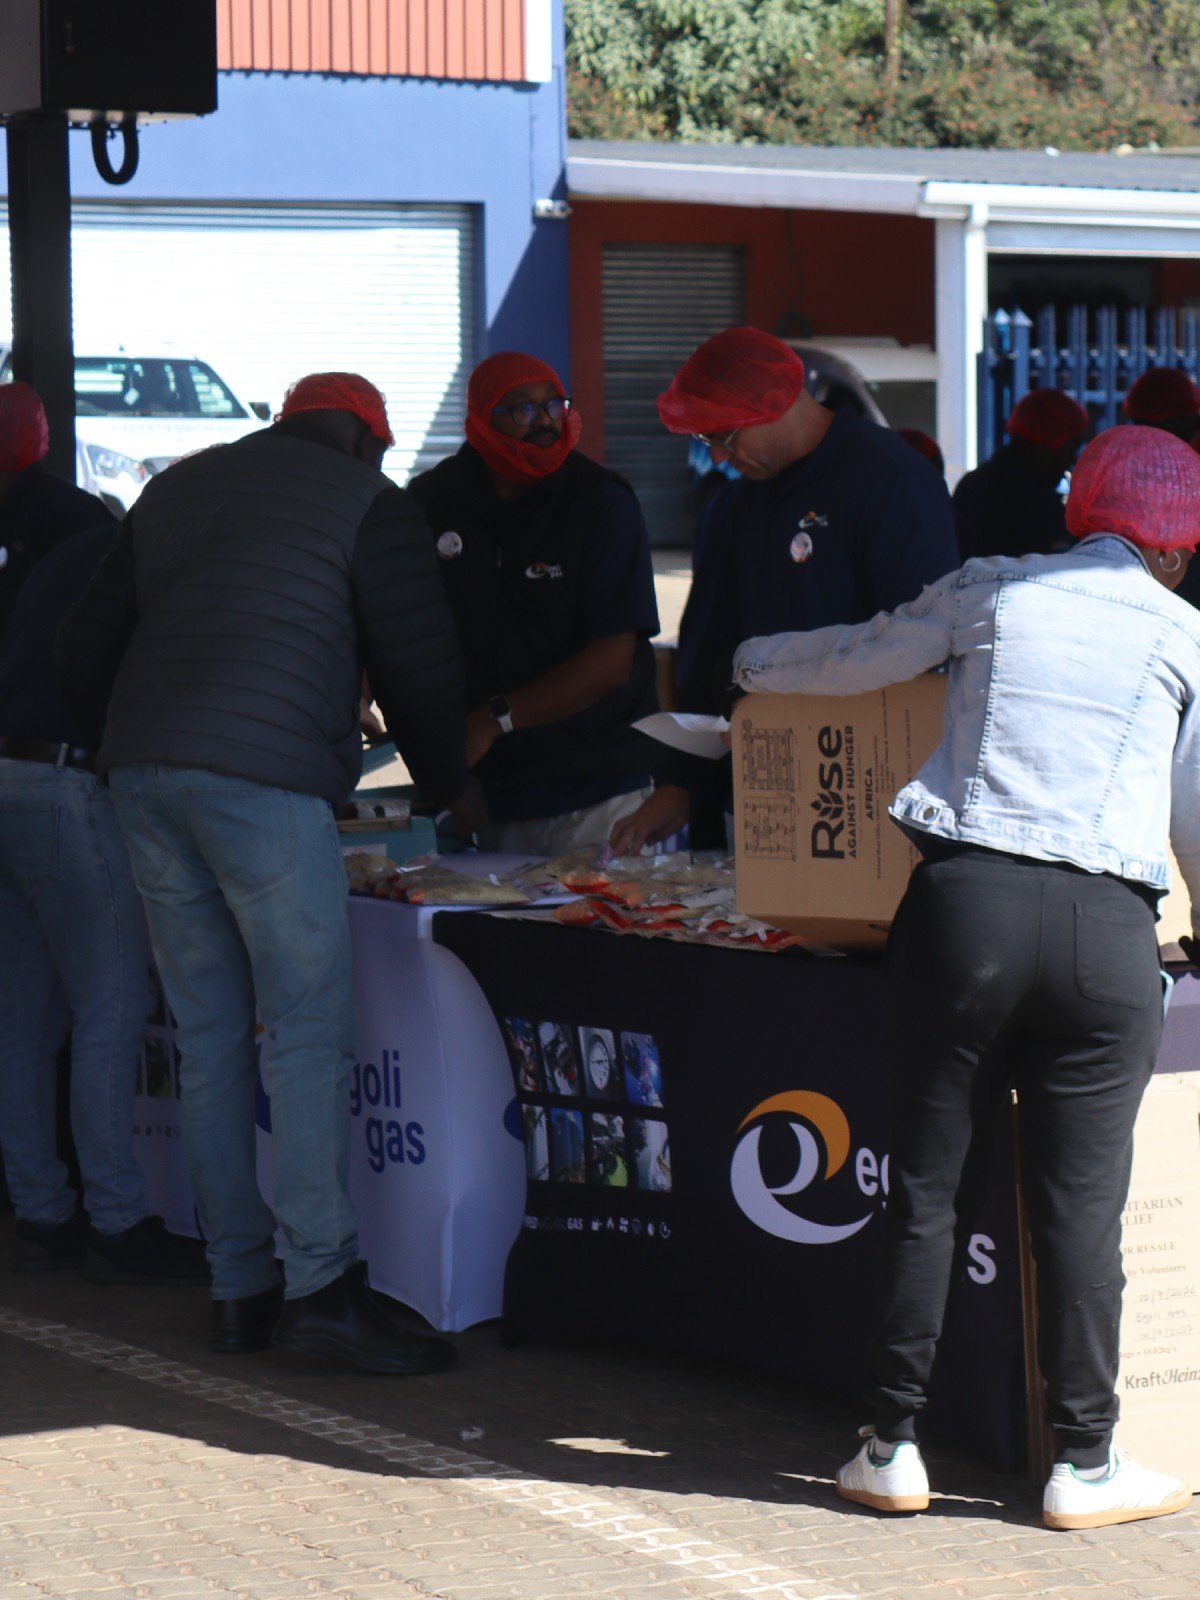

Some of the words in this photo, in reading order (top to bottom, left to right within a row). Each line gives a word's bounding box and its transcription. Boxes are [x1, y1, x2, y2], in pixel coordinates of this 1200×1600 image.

[845, 725, 855, 790] HUNGER
[811, 725, 845, 860] Rise
[863, 767, 874, 821] AFRICA
[845, 795, 857, 859] AGAINST
[350, 1049, 402, 1117] goli
[365, 1116, 426, 1174] gas
[1125, 1196, 1184, 1213] ITARIAN
[1137, 1241, 1178, 1255] RESALE
[1139, 1264, 1188, 1276] Volunteers
